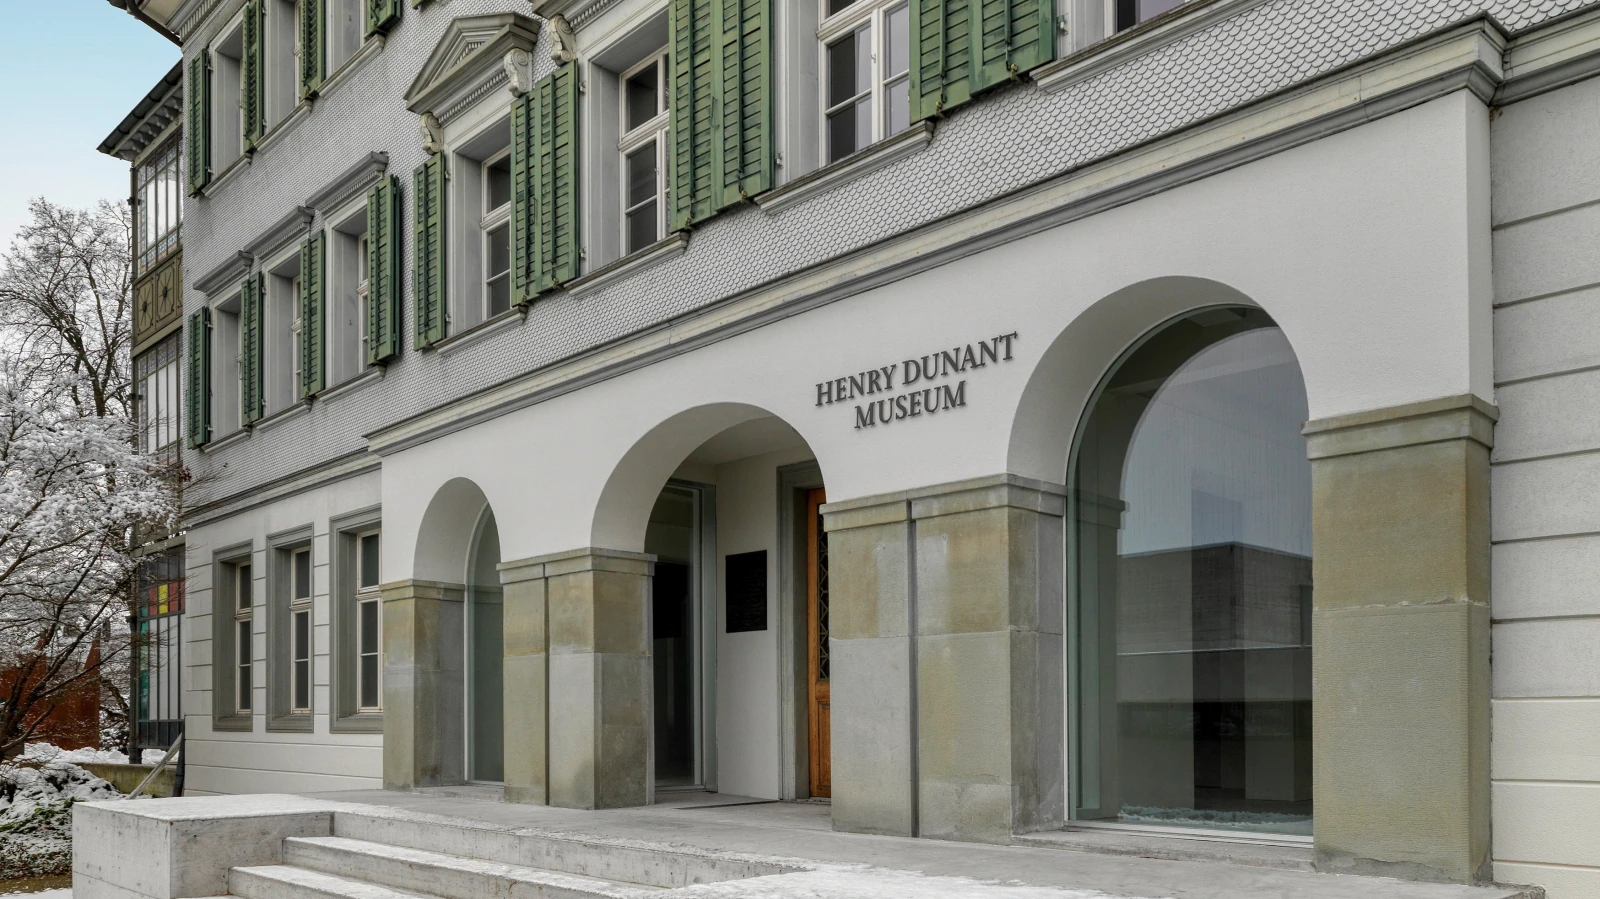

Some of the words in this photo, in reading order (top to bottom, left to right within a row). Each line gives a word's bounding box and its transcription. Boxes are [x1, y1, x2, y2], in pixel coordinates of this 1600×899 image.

[815, 364, 896, 407] HENRY
[902, 331, 1018, 385] DUNANT
[854, 380, 966, 429] MUSEUM
